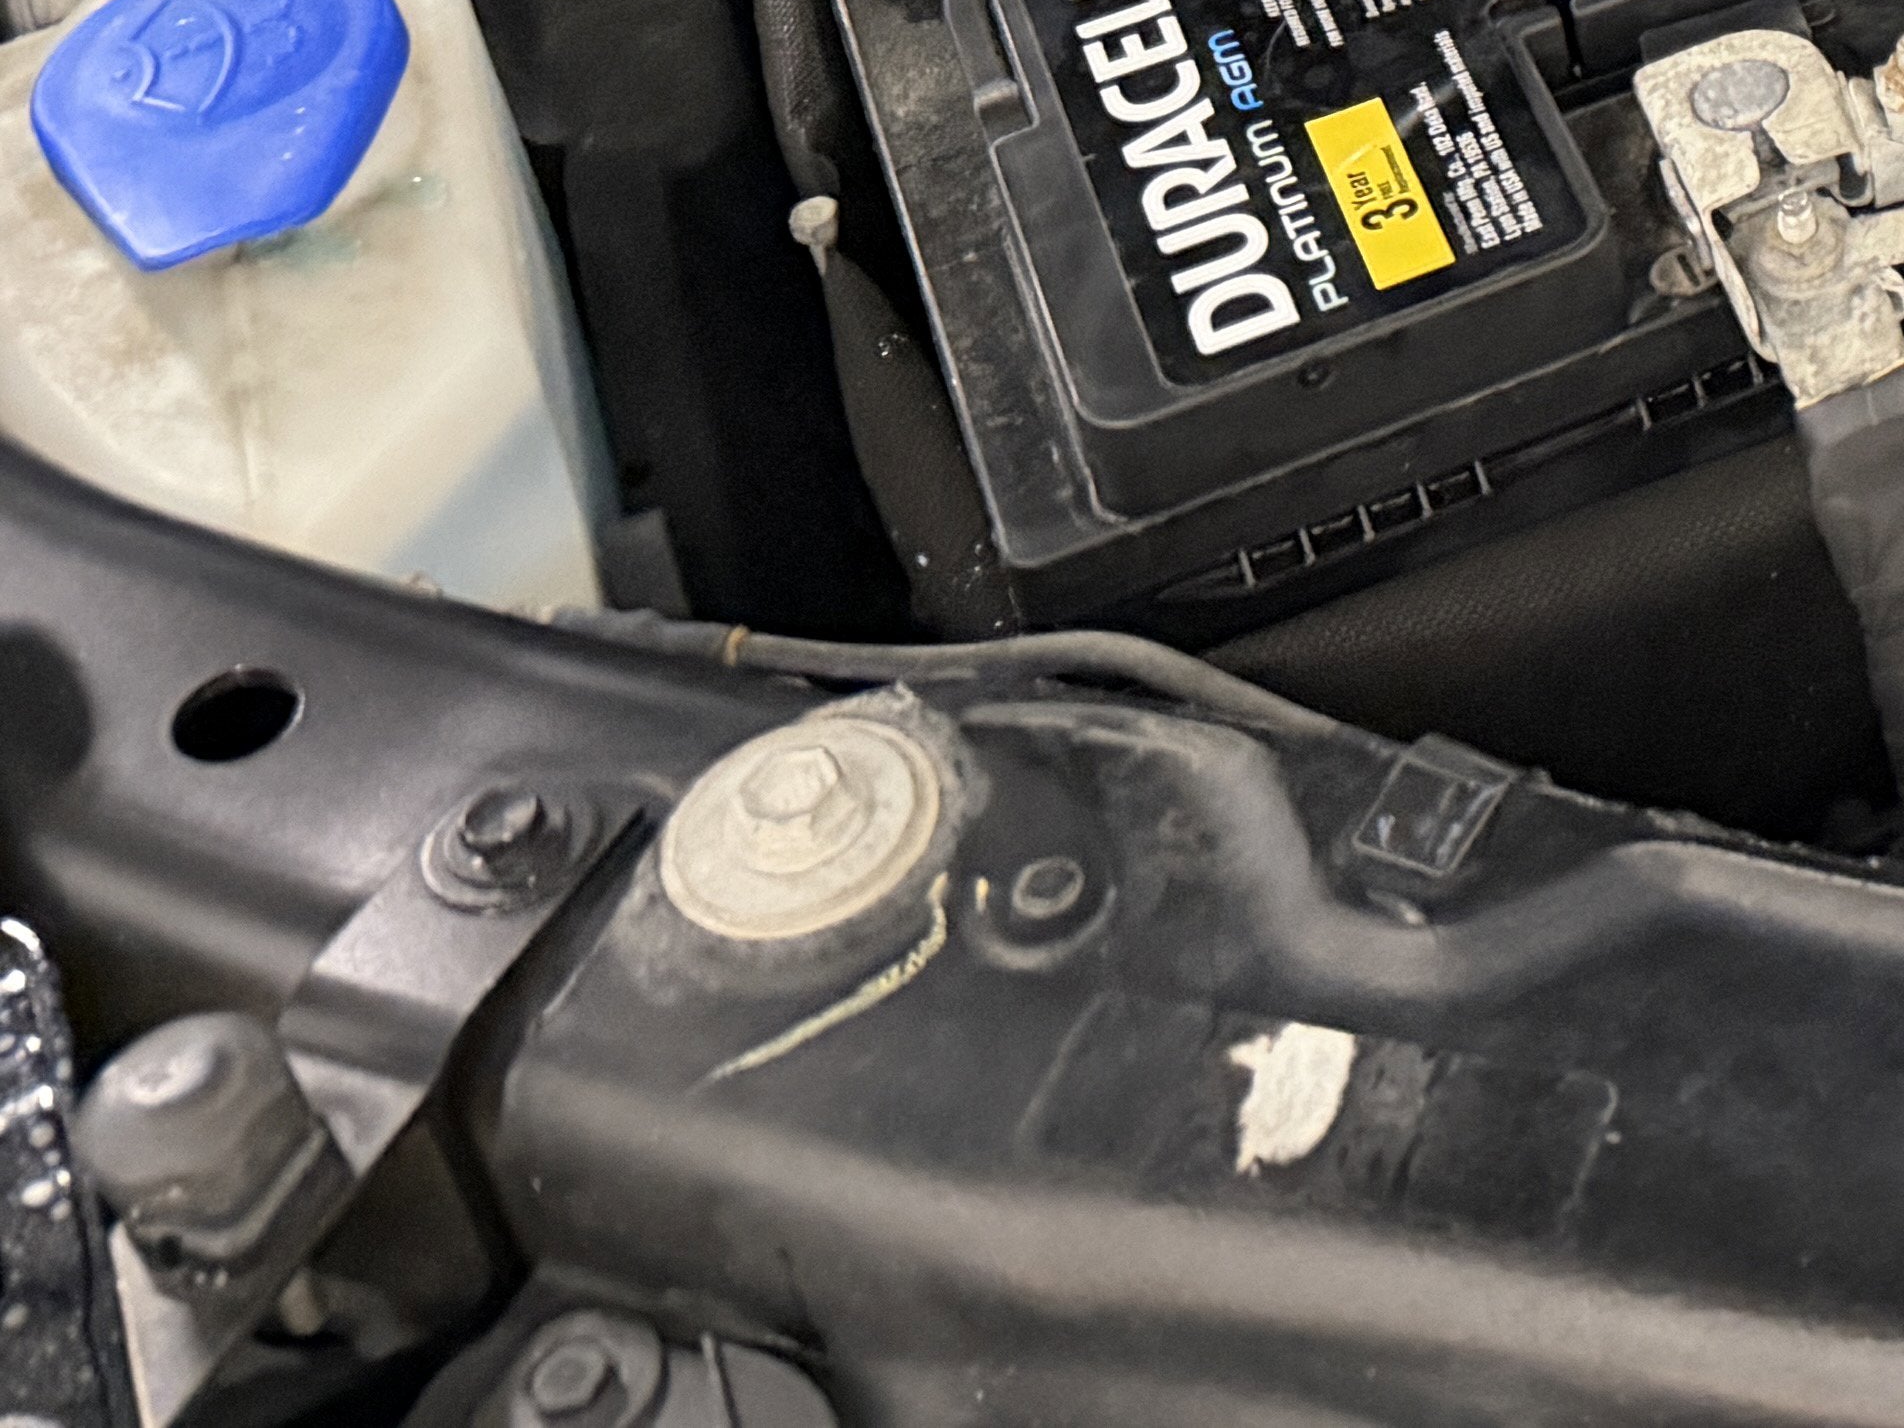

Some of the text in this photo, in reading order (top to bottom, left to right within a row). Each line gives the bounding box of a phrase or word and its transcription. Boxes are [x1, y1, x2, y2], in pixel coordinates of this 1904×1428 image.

[1420, 107, 1447, 136] Deka
[1432, 28, 1543, 232] Made in USA with US and imported materials
[1431, 132, 1456, 156] 102
[1206, 27, 1349, 312] PLATINUM AGM
[1470, 160, 1490, 178] PA
[1344, 168, 1378, 211] Year
[1356, 193, 1421, 235] 3
[1461, 196, 1489, 226] Penn
[1497, 211, 1522, 240] Lyon
[1473, 222, 1500, 249] East
